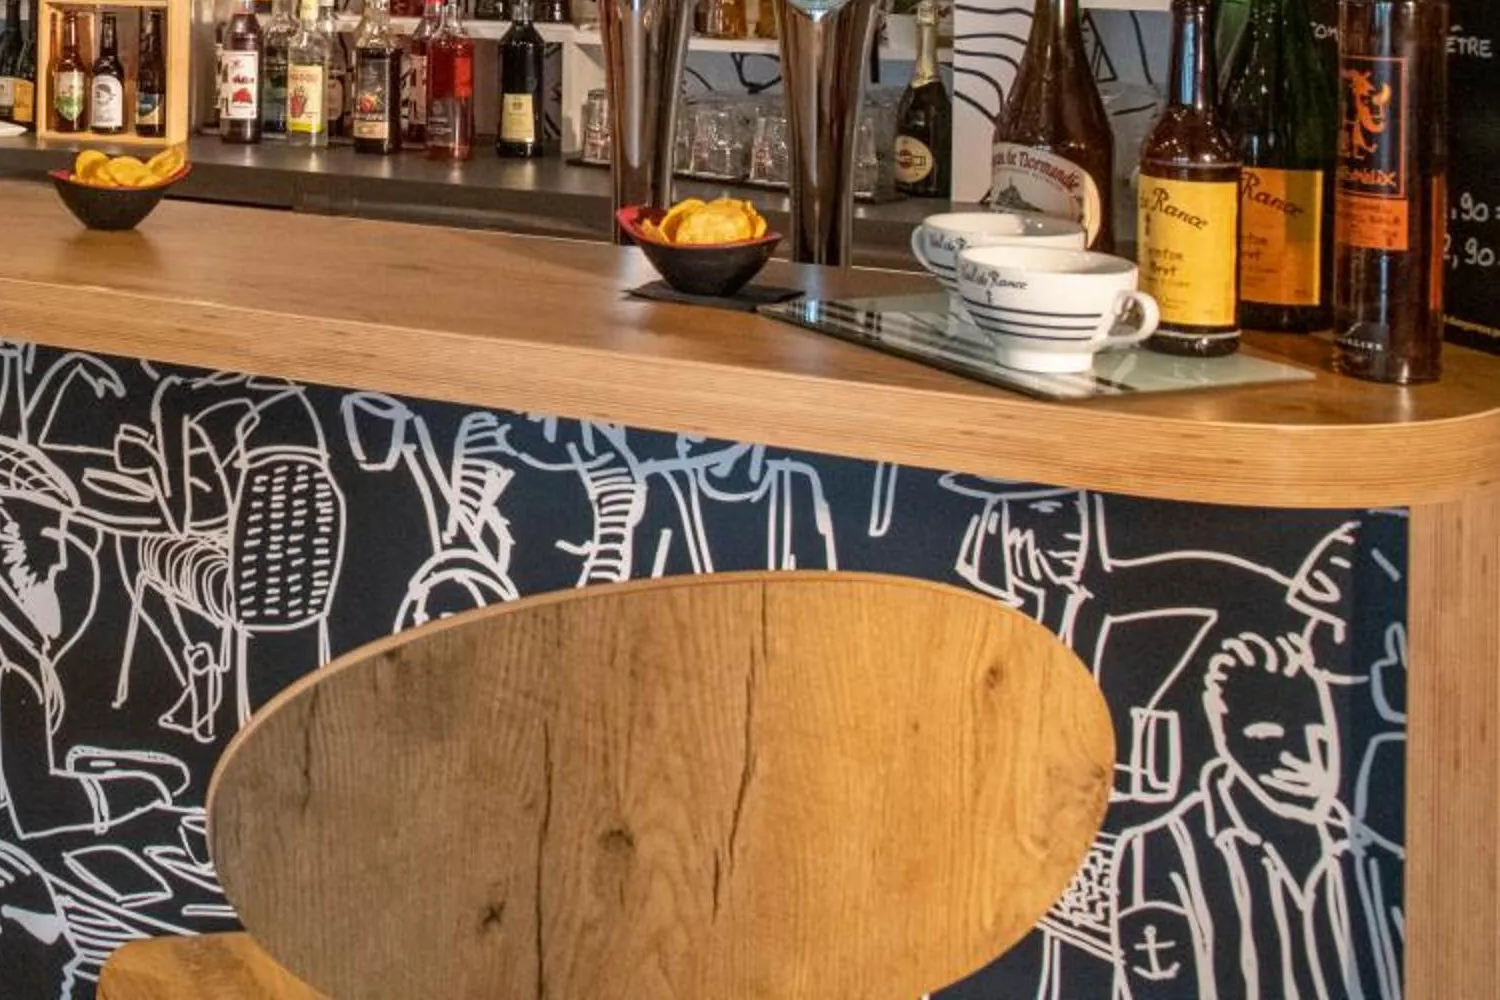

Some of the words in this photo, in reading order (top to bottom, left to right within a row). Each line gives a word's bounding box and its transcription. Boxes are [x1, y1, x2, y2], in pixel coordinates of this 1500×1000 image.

[1152, 186, 1209, 231] Rance
[1242, 170, 1305, 218] Rance
[1450, 191, 1489, 222] ,90
